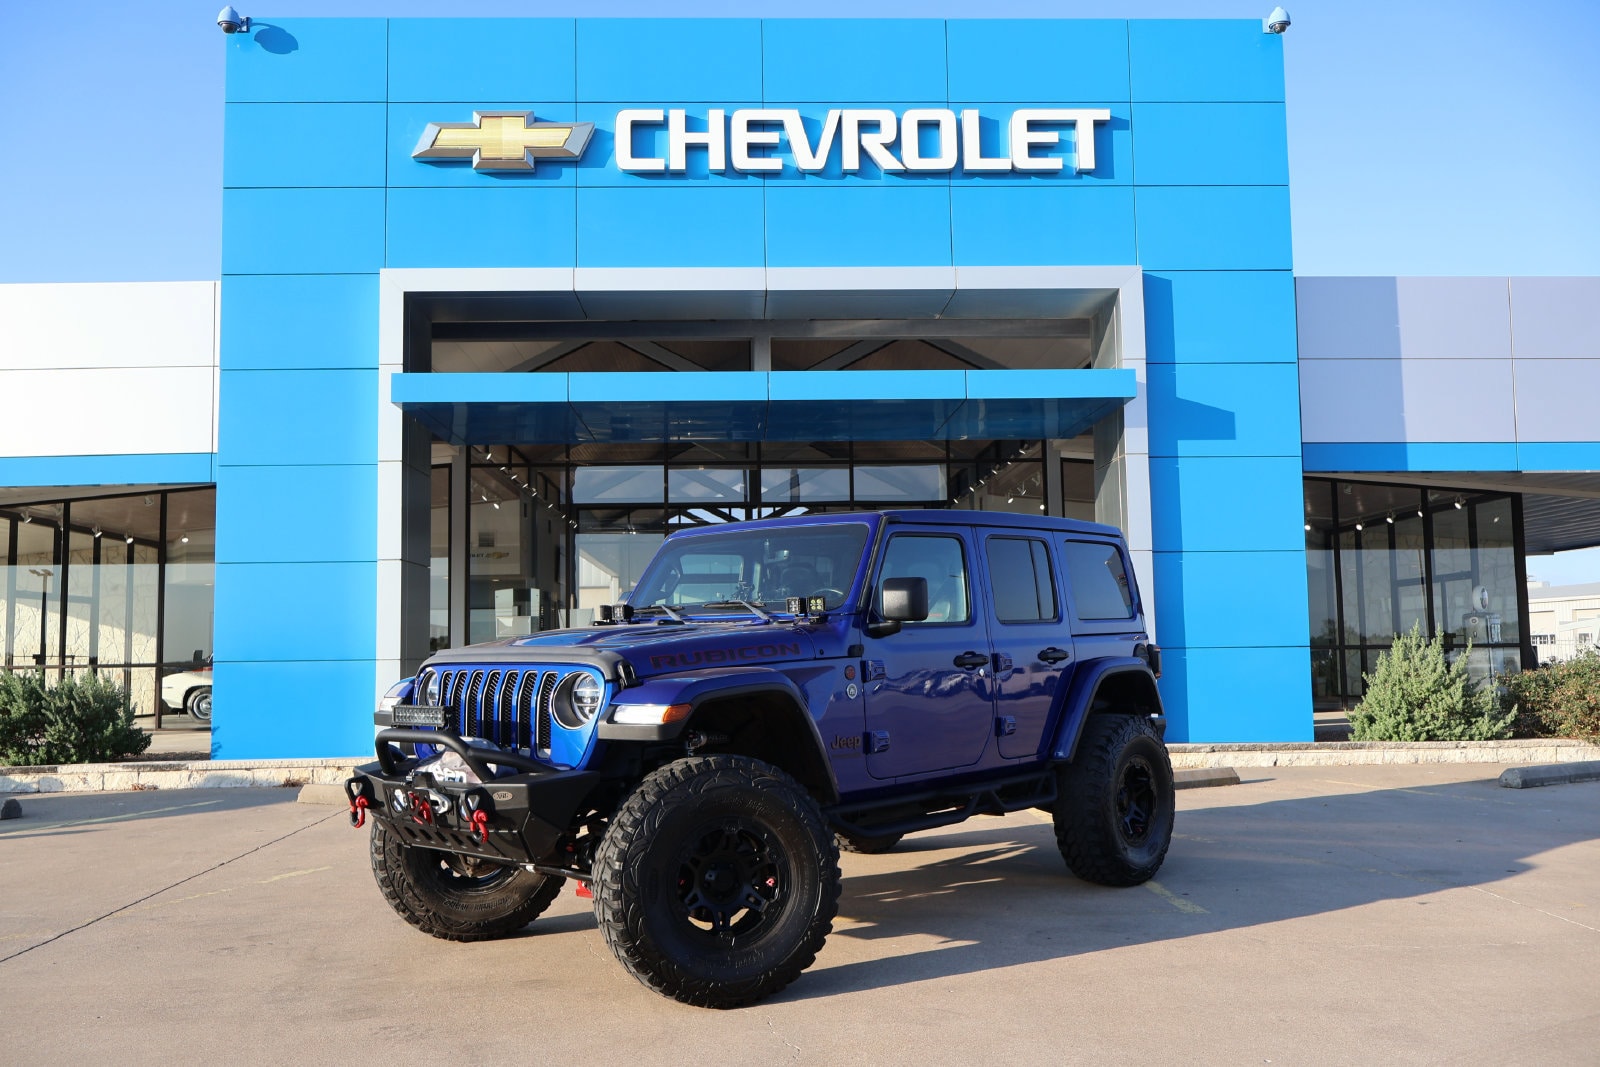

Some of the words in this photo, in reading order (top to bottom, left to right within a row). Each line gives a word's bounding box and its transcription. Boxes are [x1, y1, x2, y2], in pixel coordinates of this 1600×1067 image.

[614, 108, 1111, 173] CHEVROLET
[651, 643, 801, 669] RUBICON
[831, 735, 861, 750] Jeep
